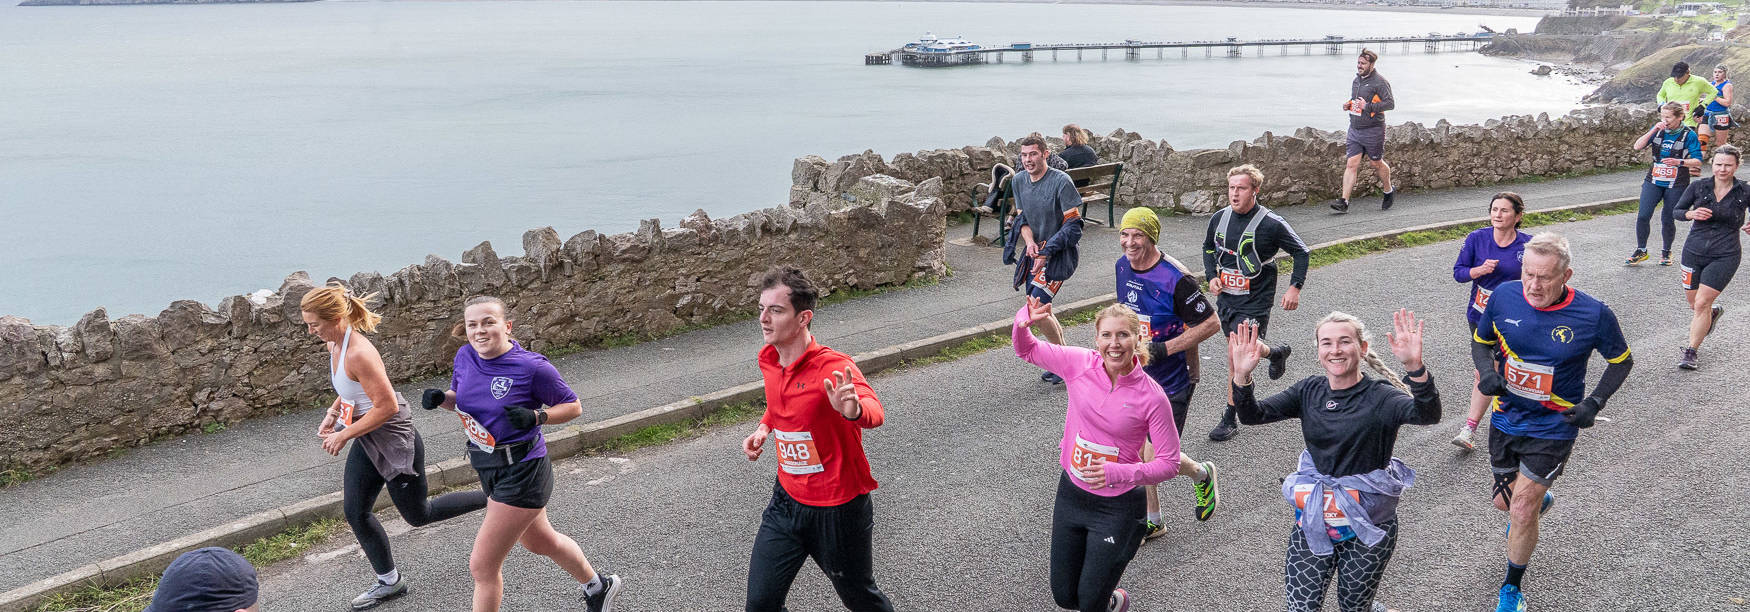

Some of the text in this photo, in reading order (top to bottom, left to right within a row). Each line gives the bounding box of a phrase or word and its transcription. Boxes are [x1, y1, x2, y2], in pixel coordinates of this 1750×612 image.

[1223, 275, 1246, 287] 150
[1507, 366, 1542, 389] 571
[778, 441, 810, 461] 948
